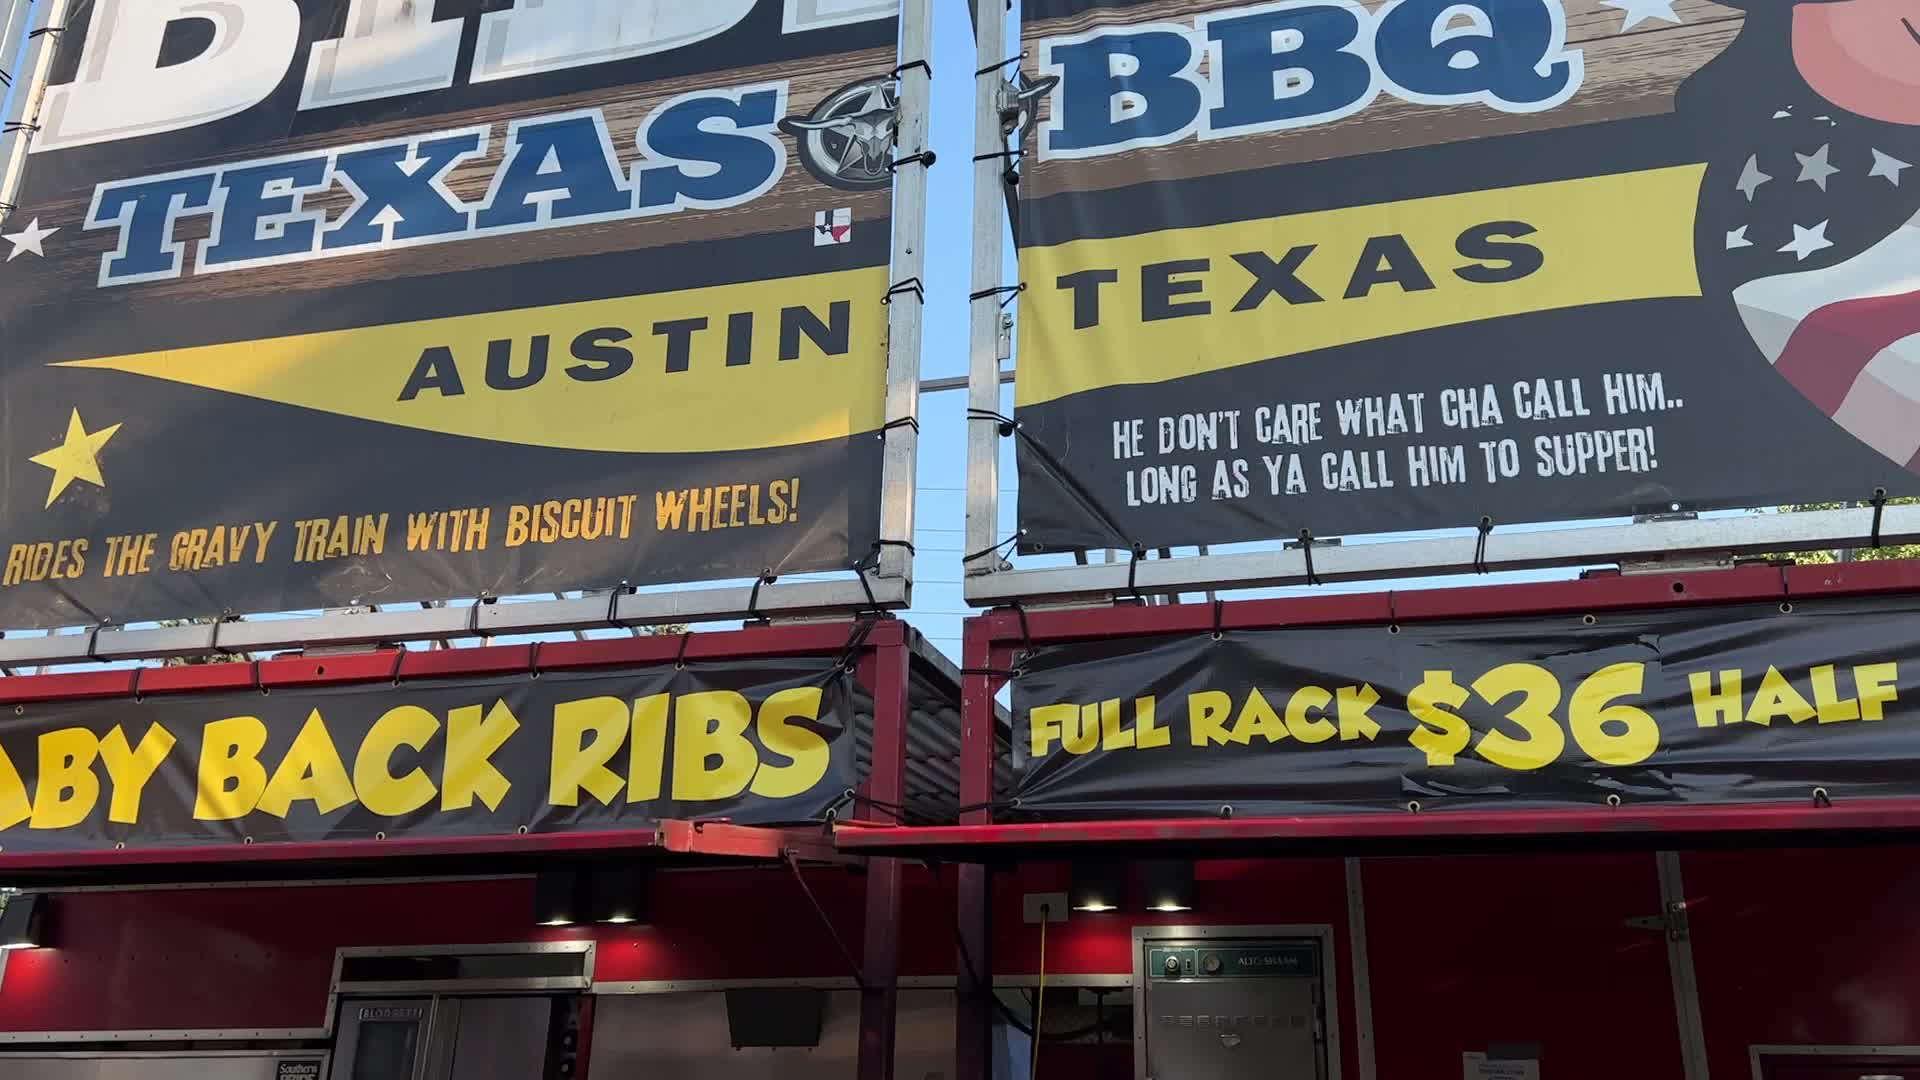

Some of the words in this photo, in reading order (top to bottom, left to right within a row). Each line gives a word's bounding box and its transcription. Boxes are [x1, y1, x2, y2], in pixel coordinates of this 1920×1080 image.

[1038, 0, 1584, 162] BBQ
[84, 81, 789, 288] TEXAS
[1056, 220, 1545, 330] TEXAS
[396, 299, 851, 401] AUSTIN
[1114, 419, 1143, 459] HE
[1159, 411, 1245, 457] DON'T
[1255, 403, 1322, 444] CARE
[1336, 393, 1424, 437] WHAT
[1441, 385, 1503, 429] CHA
[1513, 379, 1590, 420] CALL
[1603, 373, 1683, 414] HIM..
[1124, 461, 1196, 506] LONG
[1212, 459, 1249, 499] AS
[1262, 454, 1306, 495] YA
[1321, 450, 1393, 491] CALL
[1408, 445, 1465, 486] HIM
[1479, 439, 1519, 483] TO
[1535, 426, 1657, 476] SUPPER!
[4, 539, 88, 585] RIDES
[104, 535, 154, 576] THE
[170, 523, 276, 569] GRAVY
[296, 513, 387, 560] TRAIN
[407, 508, 490, 553] WITH
[506, 496, 637, 547] BISCUIT
[656, 480, 799, 531] WHEELS!
[193, 701, 519, 820] BACK
[551, 688, 829, 806] RIBS
[1031, 697, 1170, 756] FULL
[1189, 684, 1379, 746] RACK
[1408, 663, 1659, 770] $36
[1691, 663, 1897, 726] HALF
